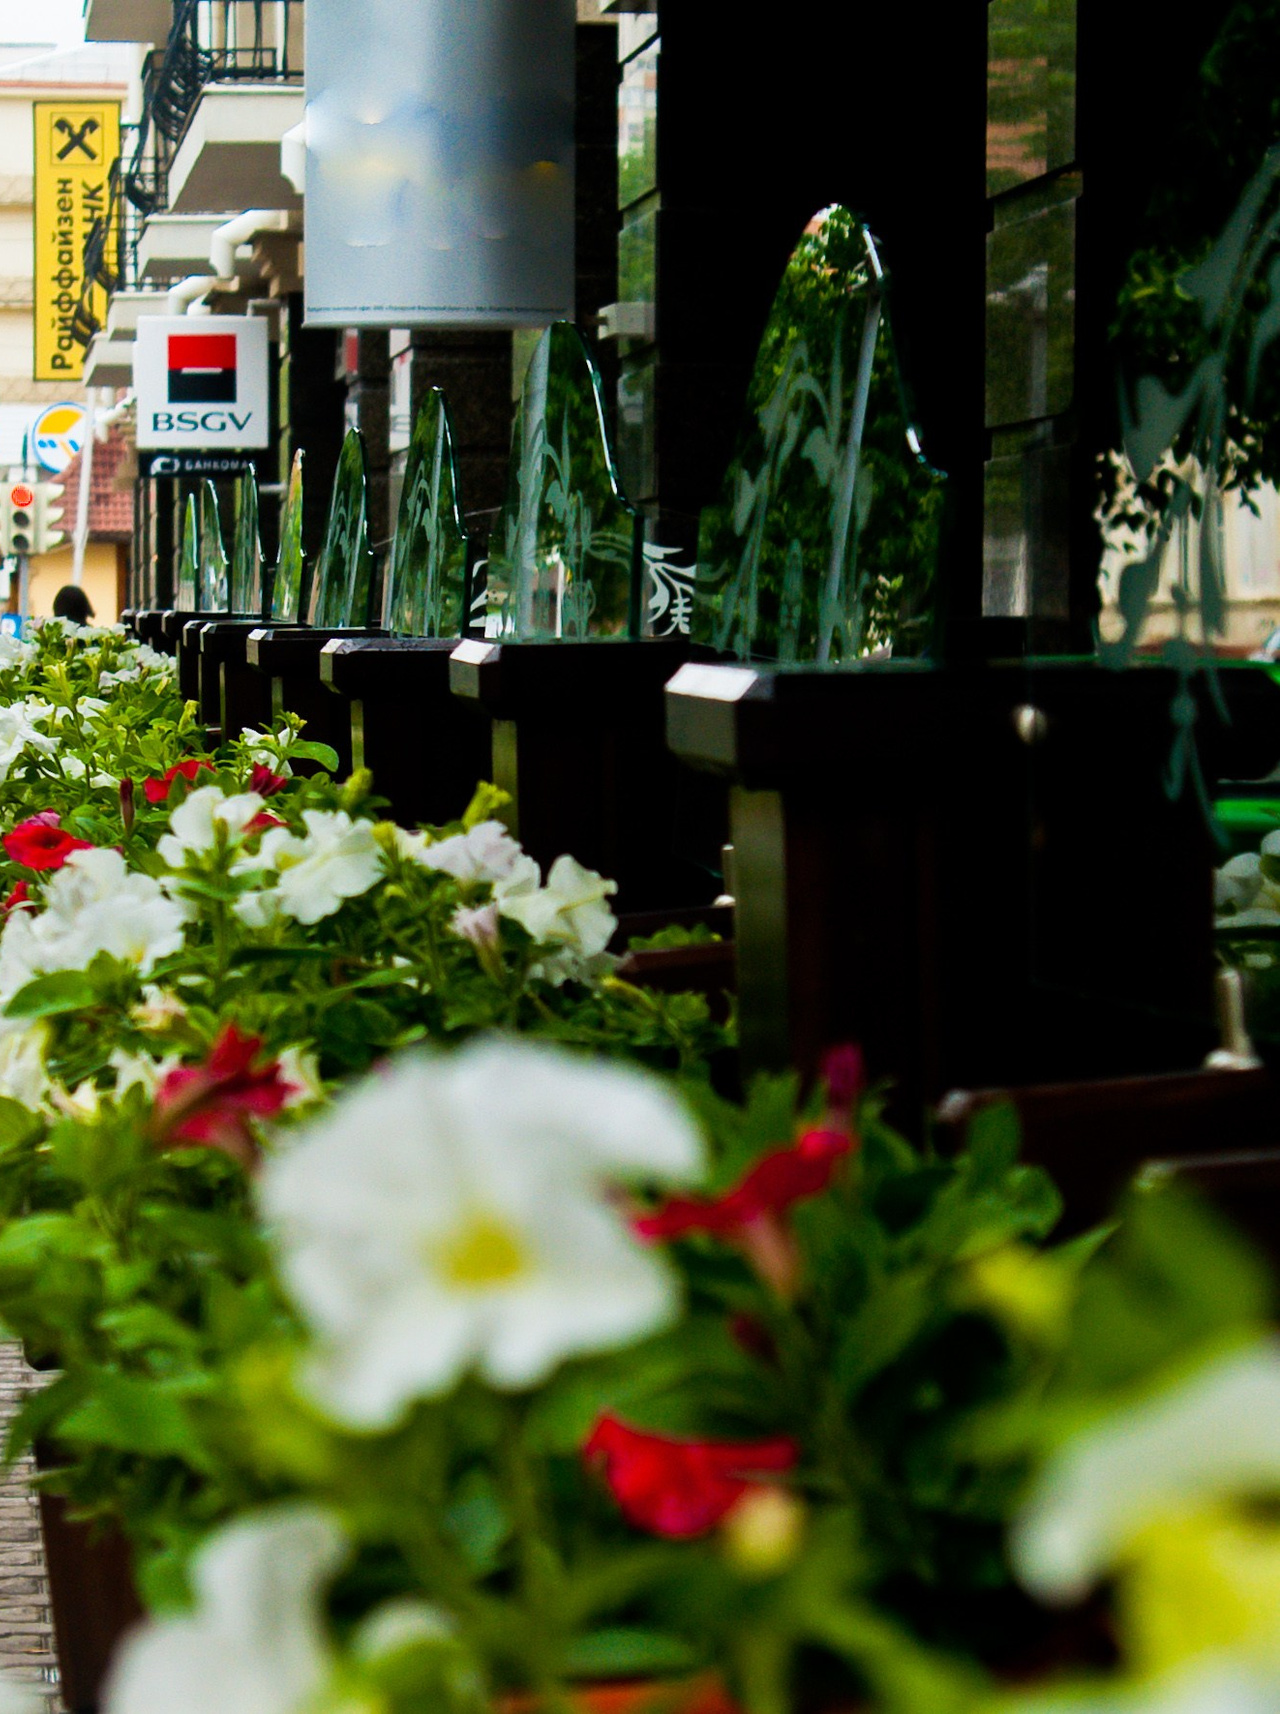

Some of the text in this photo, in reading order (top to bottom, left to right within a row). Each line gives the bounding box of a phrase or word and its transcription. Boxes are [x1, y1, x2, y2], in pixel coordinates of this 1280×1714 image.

[51, 178, 80, 370] Райффайзен
[152, 411, 253, 432] BSGV
[185, 459, 255, 471] БАНКОМА
